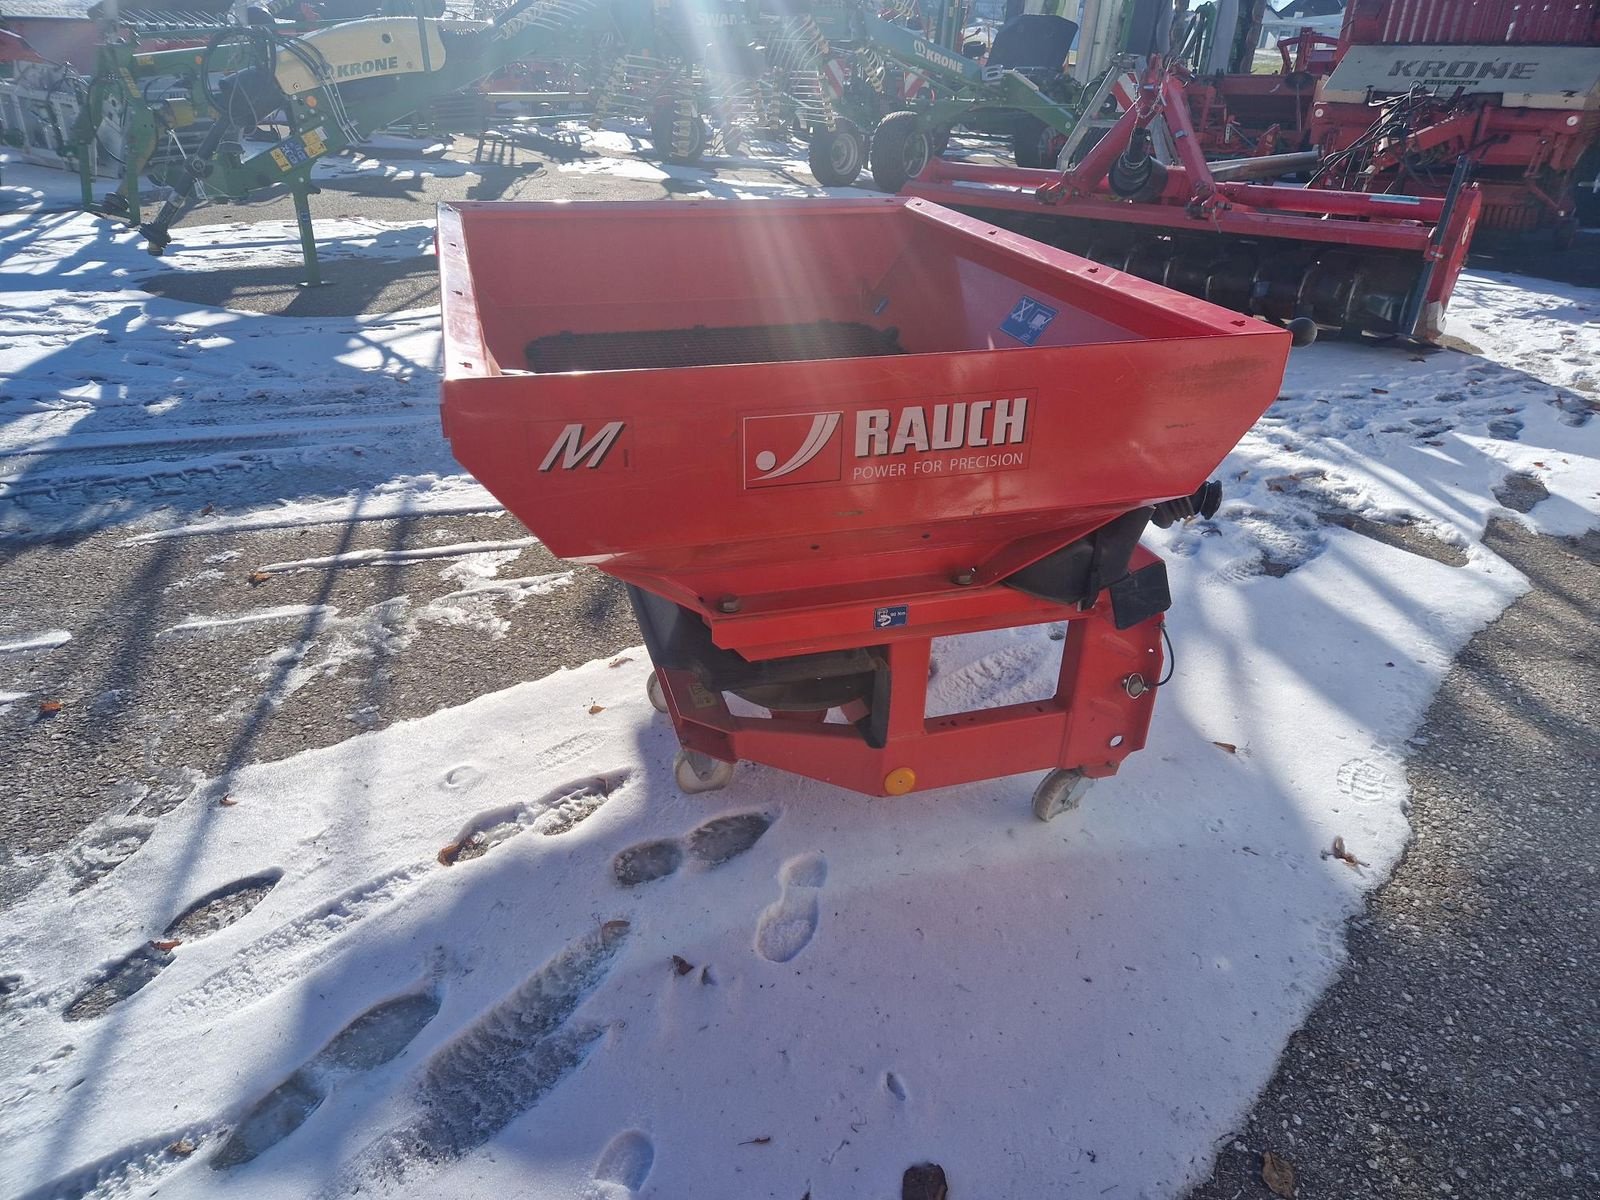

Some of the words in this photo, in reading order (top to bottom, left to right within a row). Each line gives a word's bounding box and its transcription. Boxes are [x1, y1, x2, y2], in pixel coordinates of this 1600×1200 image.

[337, 56, 399, 77] KRONE
[926, 49, 963, 73] KRONE
[1387, 59, 1539, 79] KRONE
[854, 397, 1028, 458] RAUCH
[537, 421, 626, 472] M
[853, 463, 906, 480] POWER
[913, 460, 942, 474] FOR
[950, 452, 1024, 471] PRECISION
